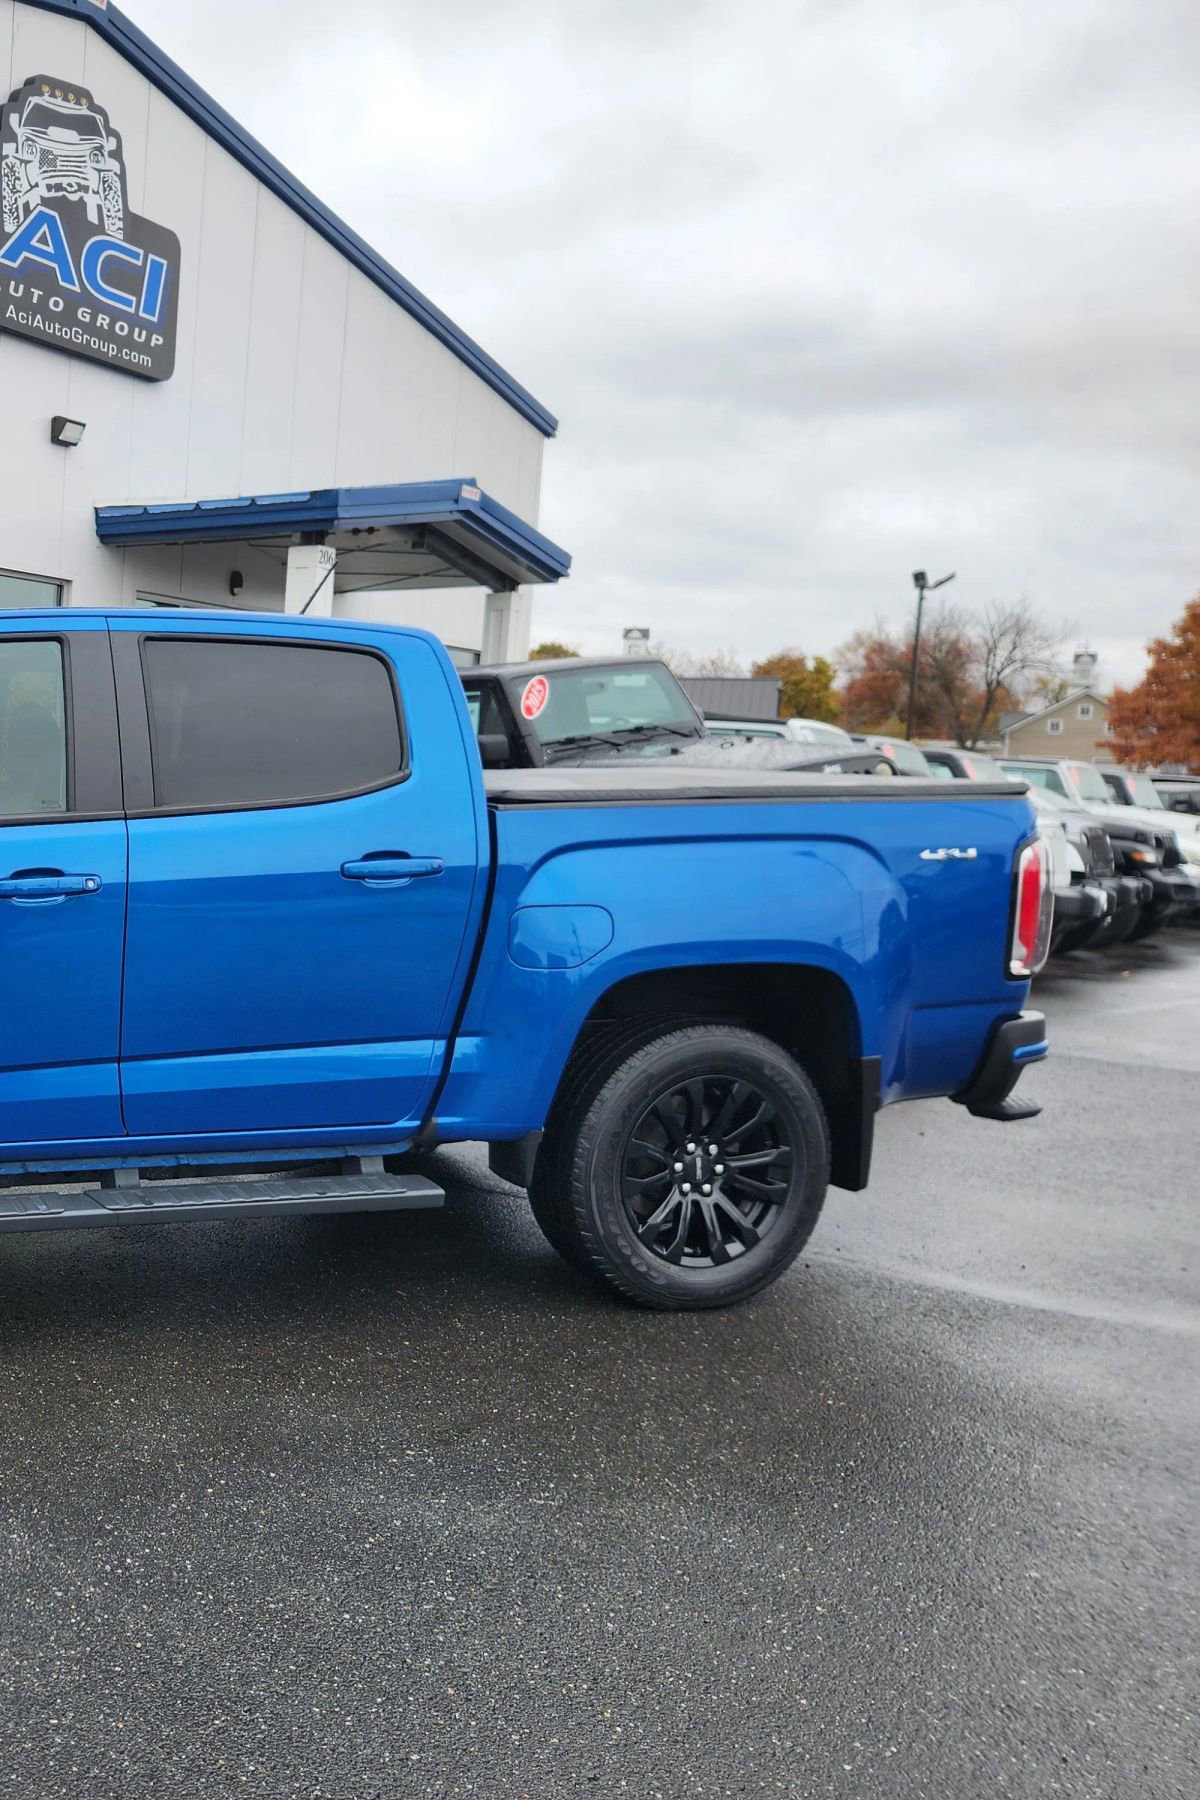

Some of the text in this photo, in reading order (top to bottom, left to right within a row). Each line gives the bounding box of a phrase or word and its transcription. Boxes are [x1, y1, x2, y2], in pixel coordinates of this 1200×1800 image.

[5, 304, 153, 368] AciAutoGroup.com
[76, 306, 164, 348] GROUP
[318, 550, 334, 565] 206
